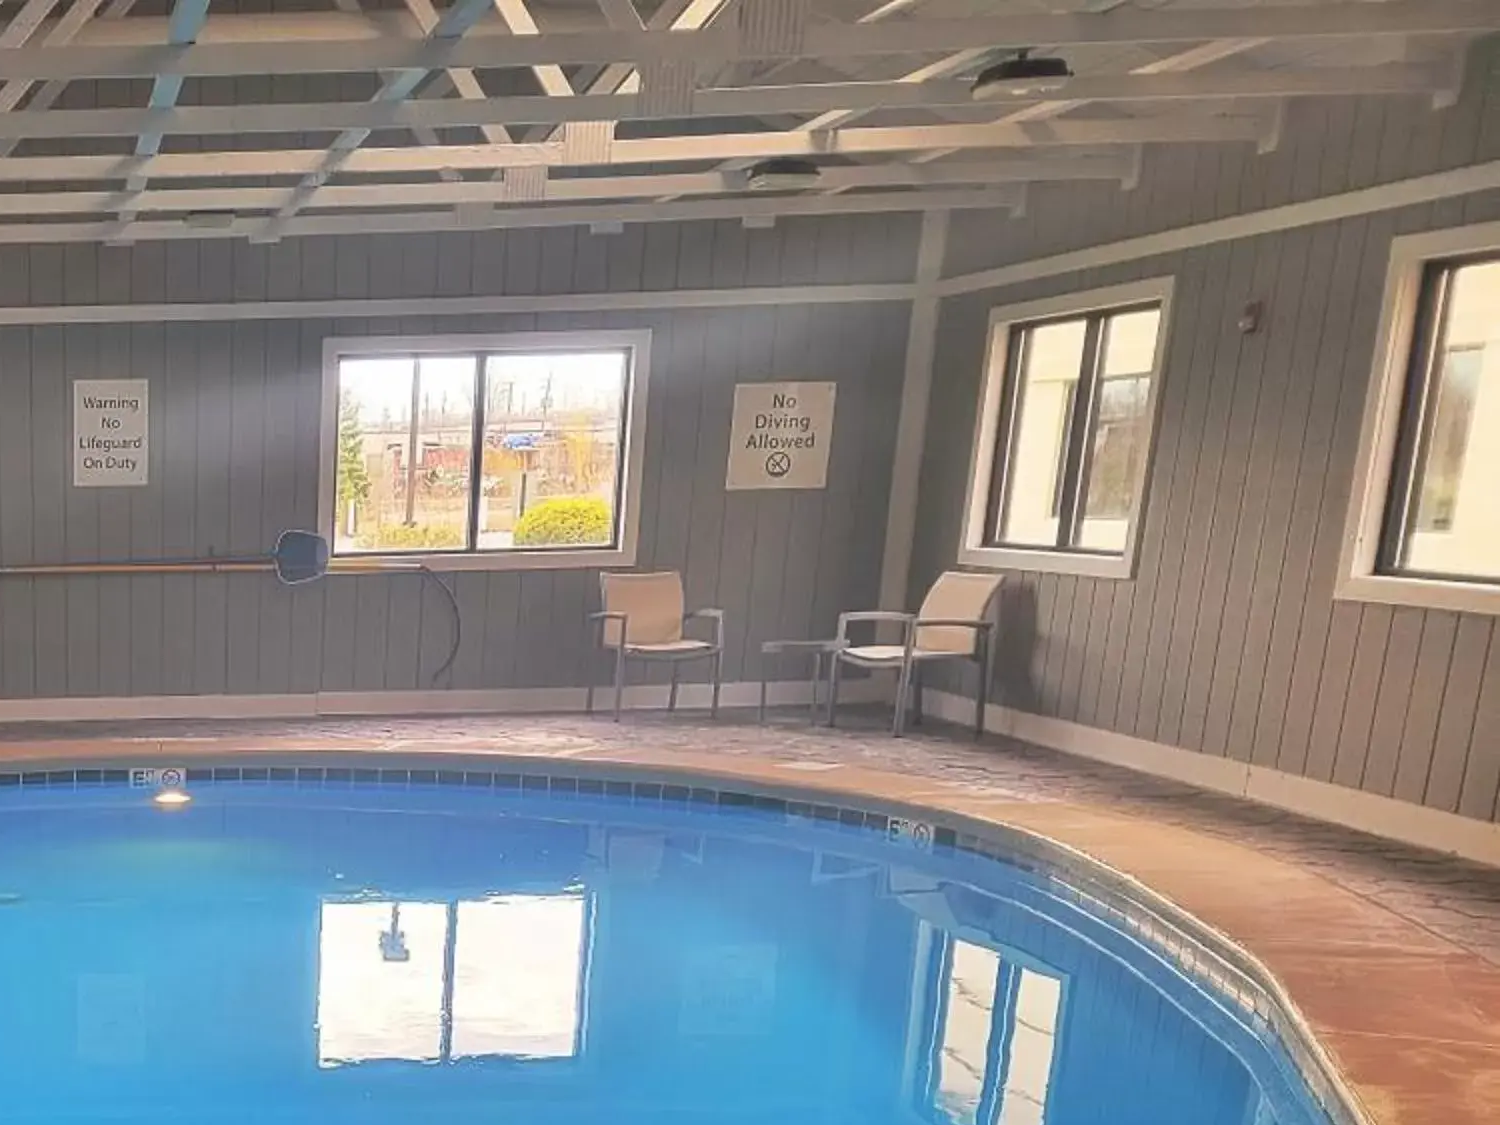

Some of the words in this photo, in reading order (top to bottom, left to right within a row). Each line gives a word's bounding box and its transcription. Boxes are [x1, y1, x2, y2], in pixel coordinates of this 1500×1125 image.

[83, 396, 139, 412] Warning
[773, 393, 797, 409] No
[101, 416, 121, 429] No
[755, 414, 810, 432] Diving
[79, 436, 142, 453] Lifeguard
[745, 432, 815, 449] Allowed
[83, 456, 103, 469] On
[106, 456, 137, 471] Duty
